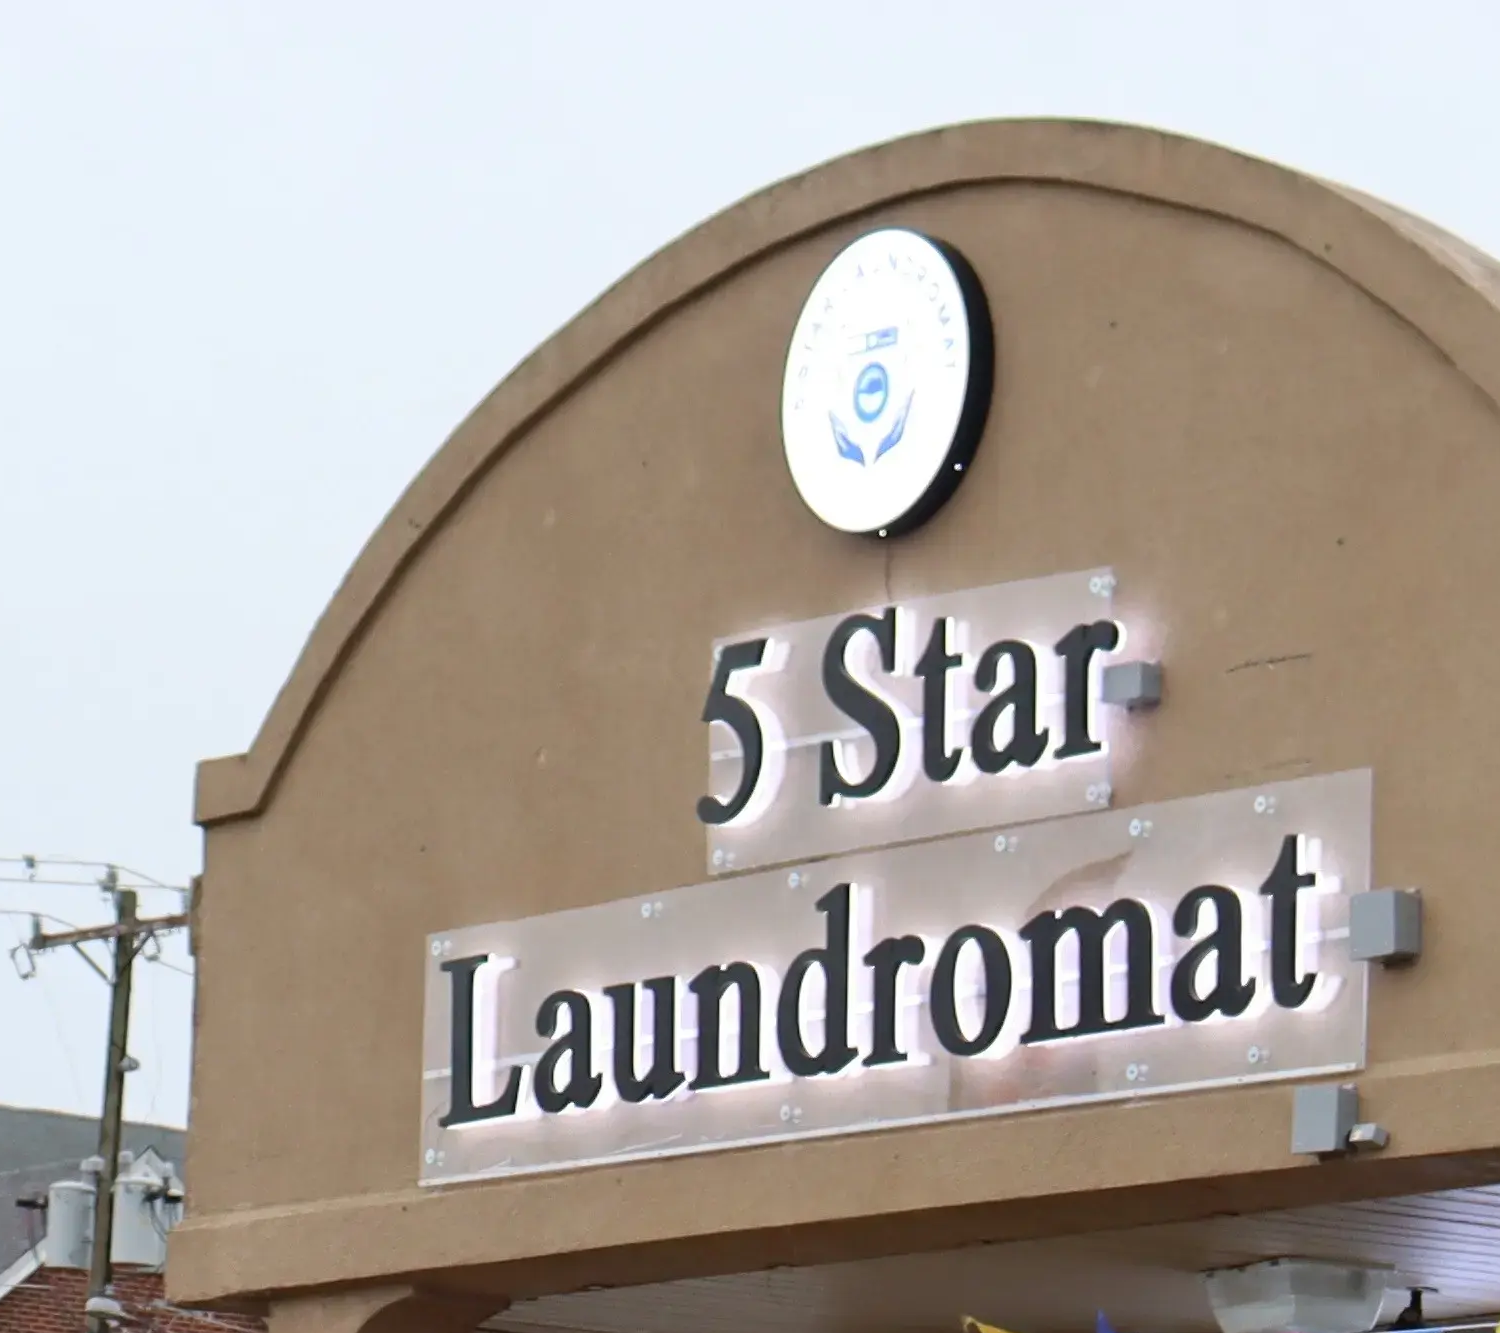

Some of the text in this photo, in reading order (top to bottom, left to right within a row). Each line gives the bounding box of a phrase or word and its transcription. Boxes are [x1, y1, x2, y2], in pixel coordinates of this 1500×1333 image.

[696, 606, 1118, 824] 5 Star
[438, 835, 1317, 1129] Laundromat
